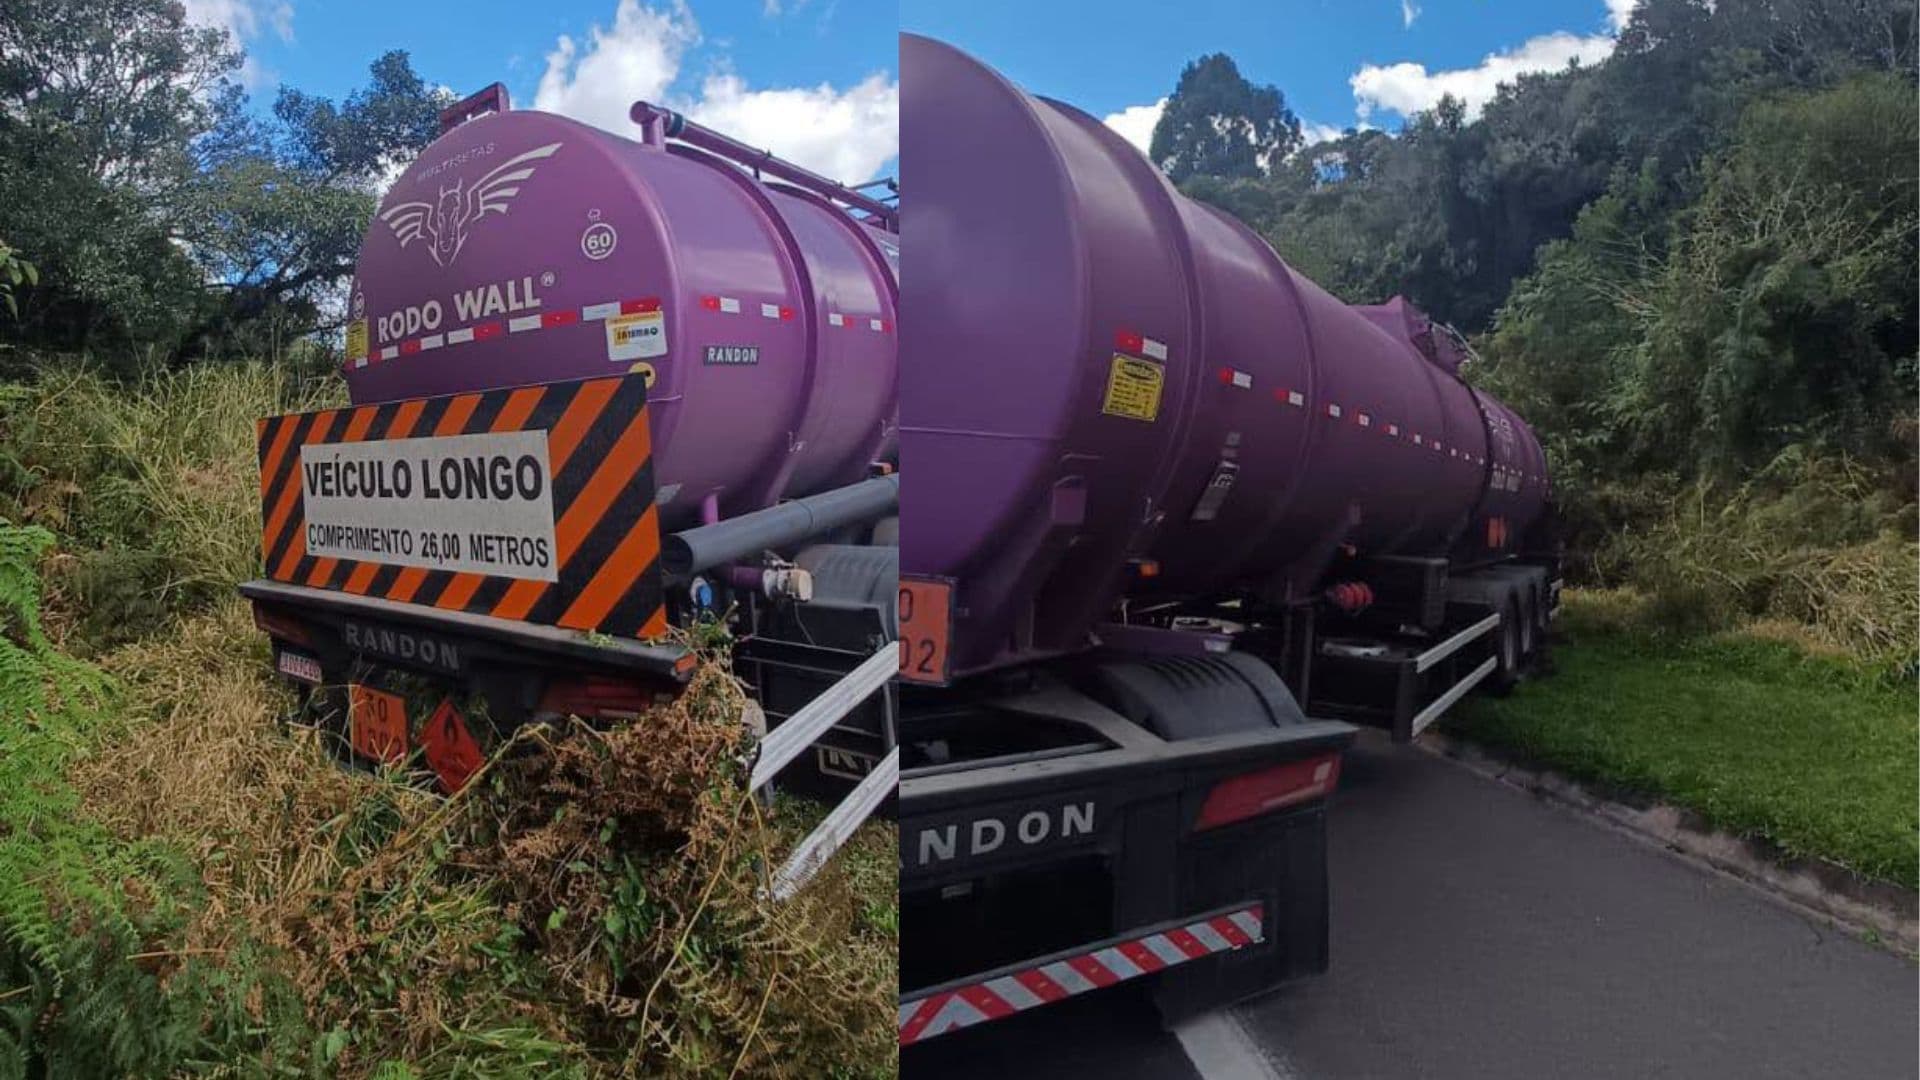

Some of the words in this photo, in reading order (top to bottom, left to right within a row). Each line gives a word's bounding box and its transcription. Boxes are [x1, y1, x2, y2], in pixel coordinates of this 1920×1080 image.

[587, 232, 611, 250] 60
[377, 300, 443, 343] RODO
[707, 347, 758, 363] RANDON
[305, 453, 412, 499] VEÍCULO
[422, 454, 542, 501] LONGO
[308, 523, 413, 556] COMPRIMENTO
[420, 531, 461, 565] 26,00
[470, 534, 549, 568] METROS
[344, 622, 461, 670] RANDON
[901, 802, 1096, 868] NDON
